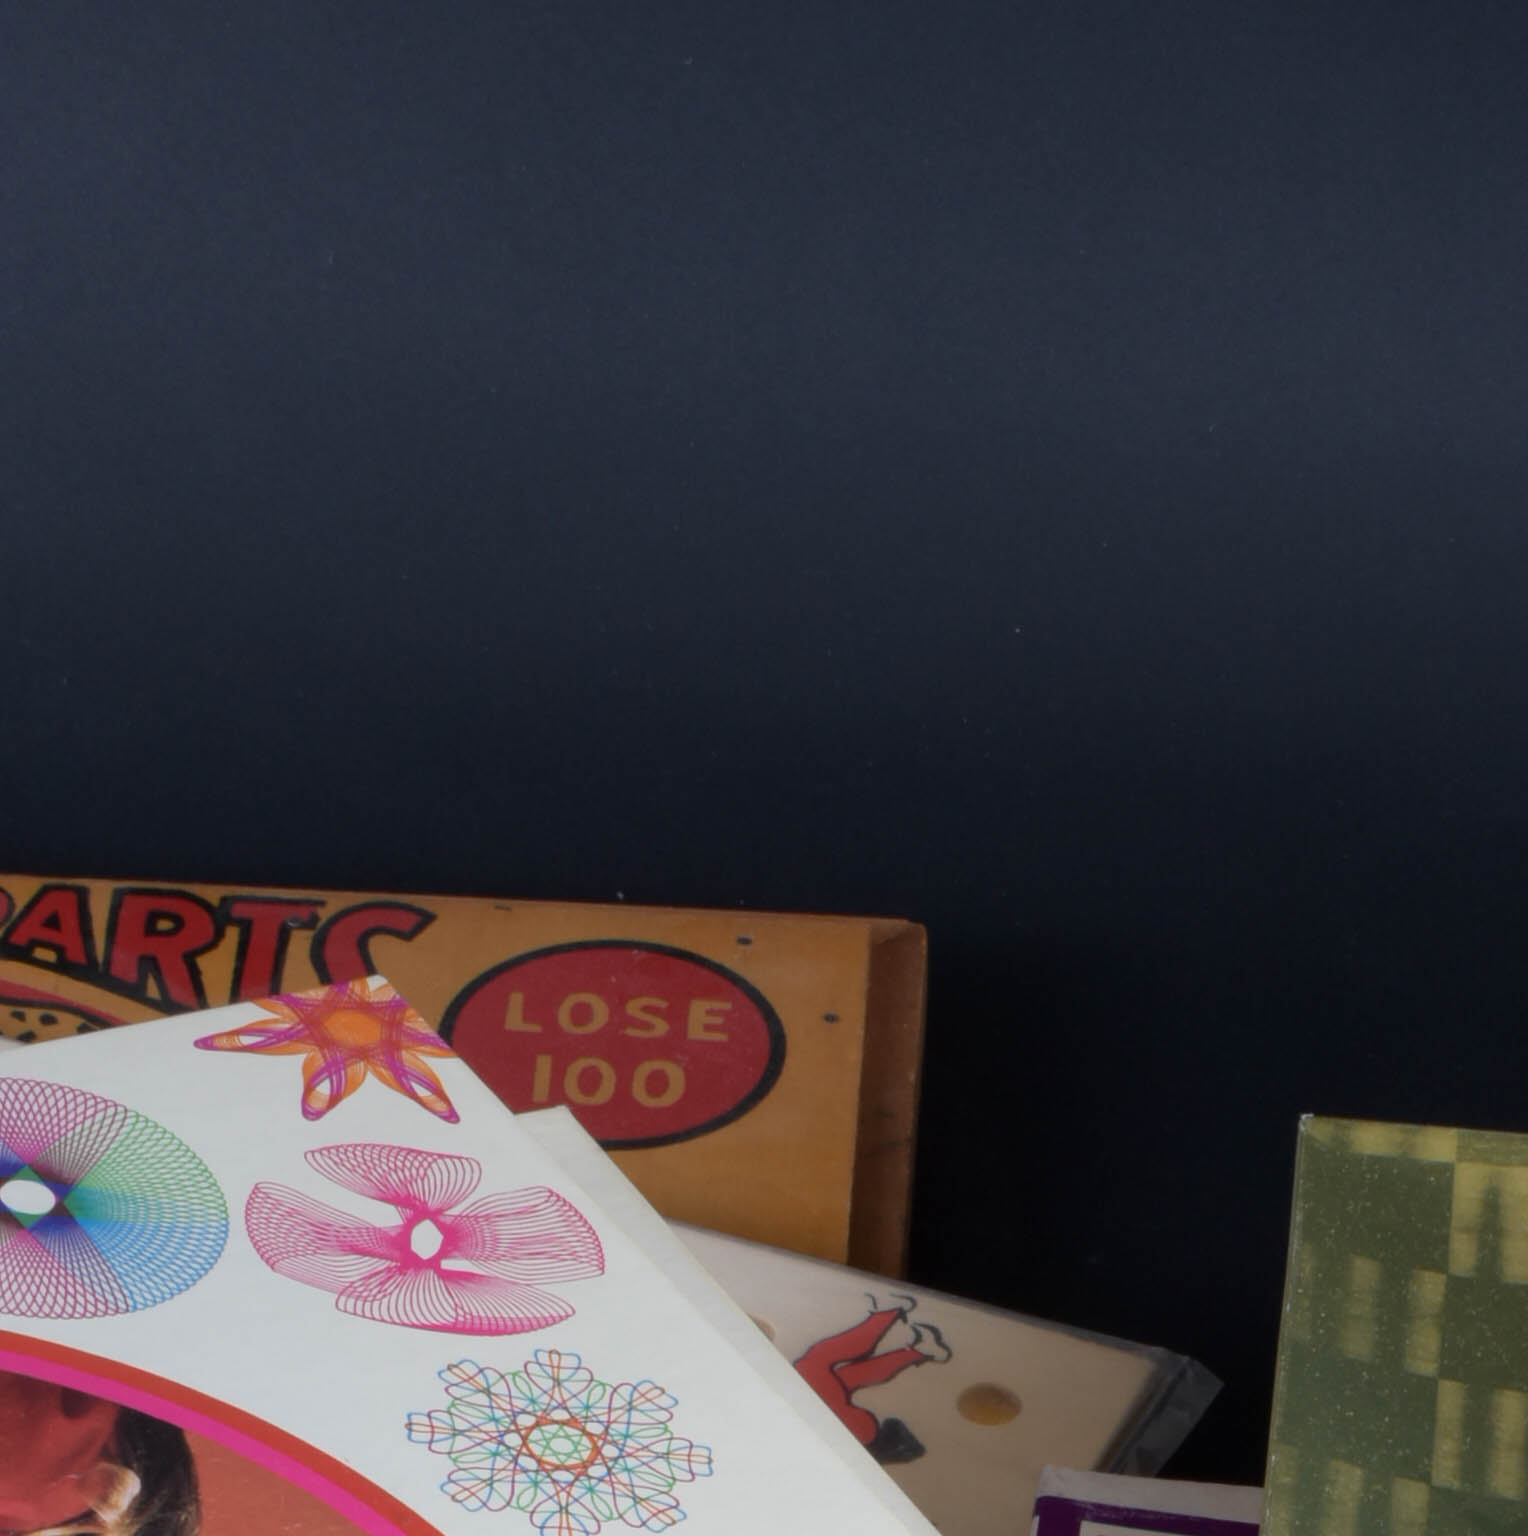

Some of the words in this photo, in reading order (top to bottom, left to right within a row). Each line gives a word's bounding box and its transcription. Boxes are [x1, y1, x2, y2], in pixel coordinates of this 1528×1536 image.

[0, 884, 437, 1015] ART
[503, 990, 734, 1046] LOSE
[531, 1055, 687, 1110] 100
